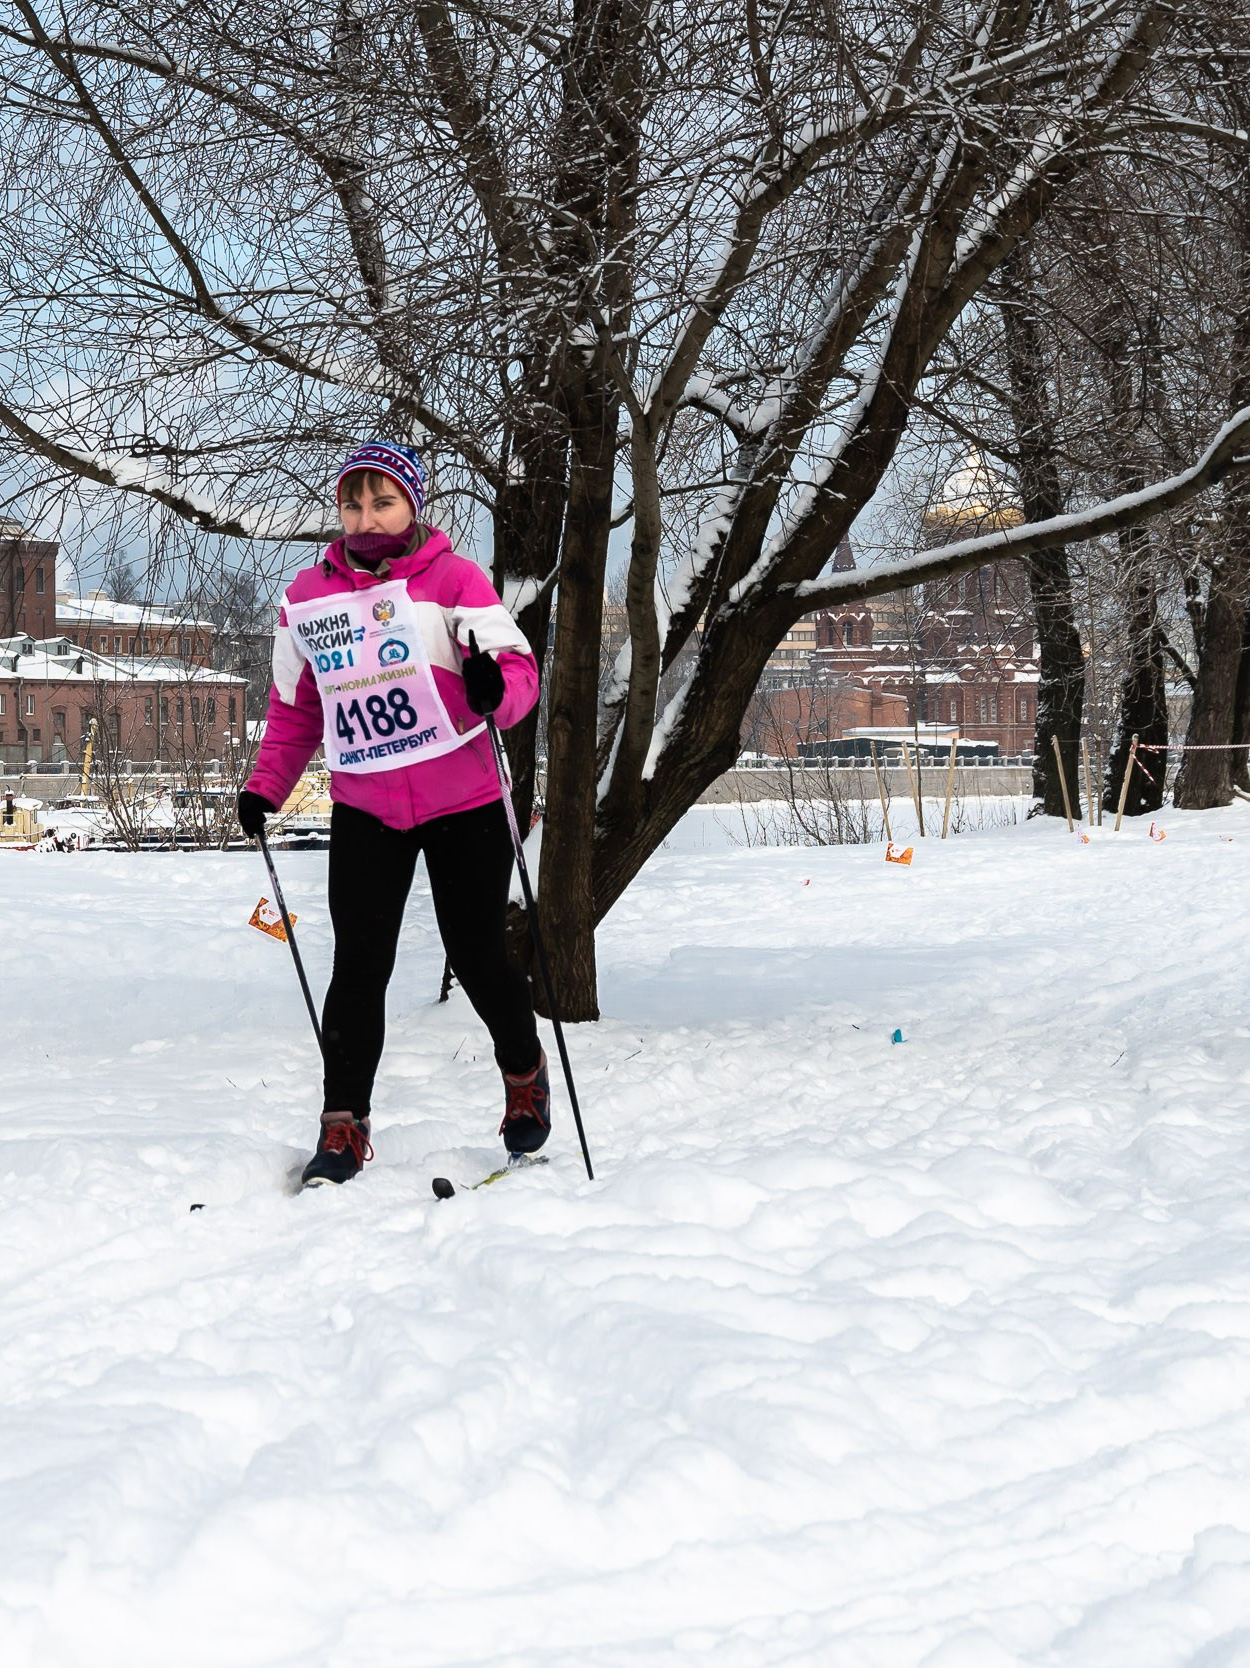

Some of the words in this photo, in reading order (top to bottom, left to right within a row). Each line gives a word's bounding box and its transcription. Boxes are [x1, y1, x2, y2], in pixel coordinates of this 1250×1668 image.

[341, 675, 377, 692] НОРМА
[377, 665, 417, 683] ЖИЗНИ
[336, 687, 418, 745] 4188
[339, 726, 438, 766] САНКТ-ПЕТЕРБУРГ
